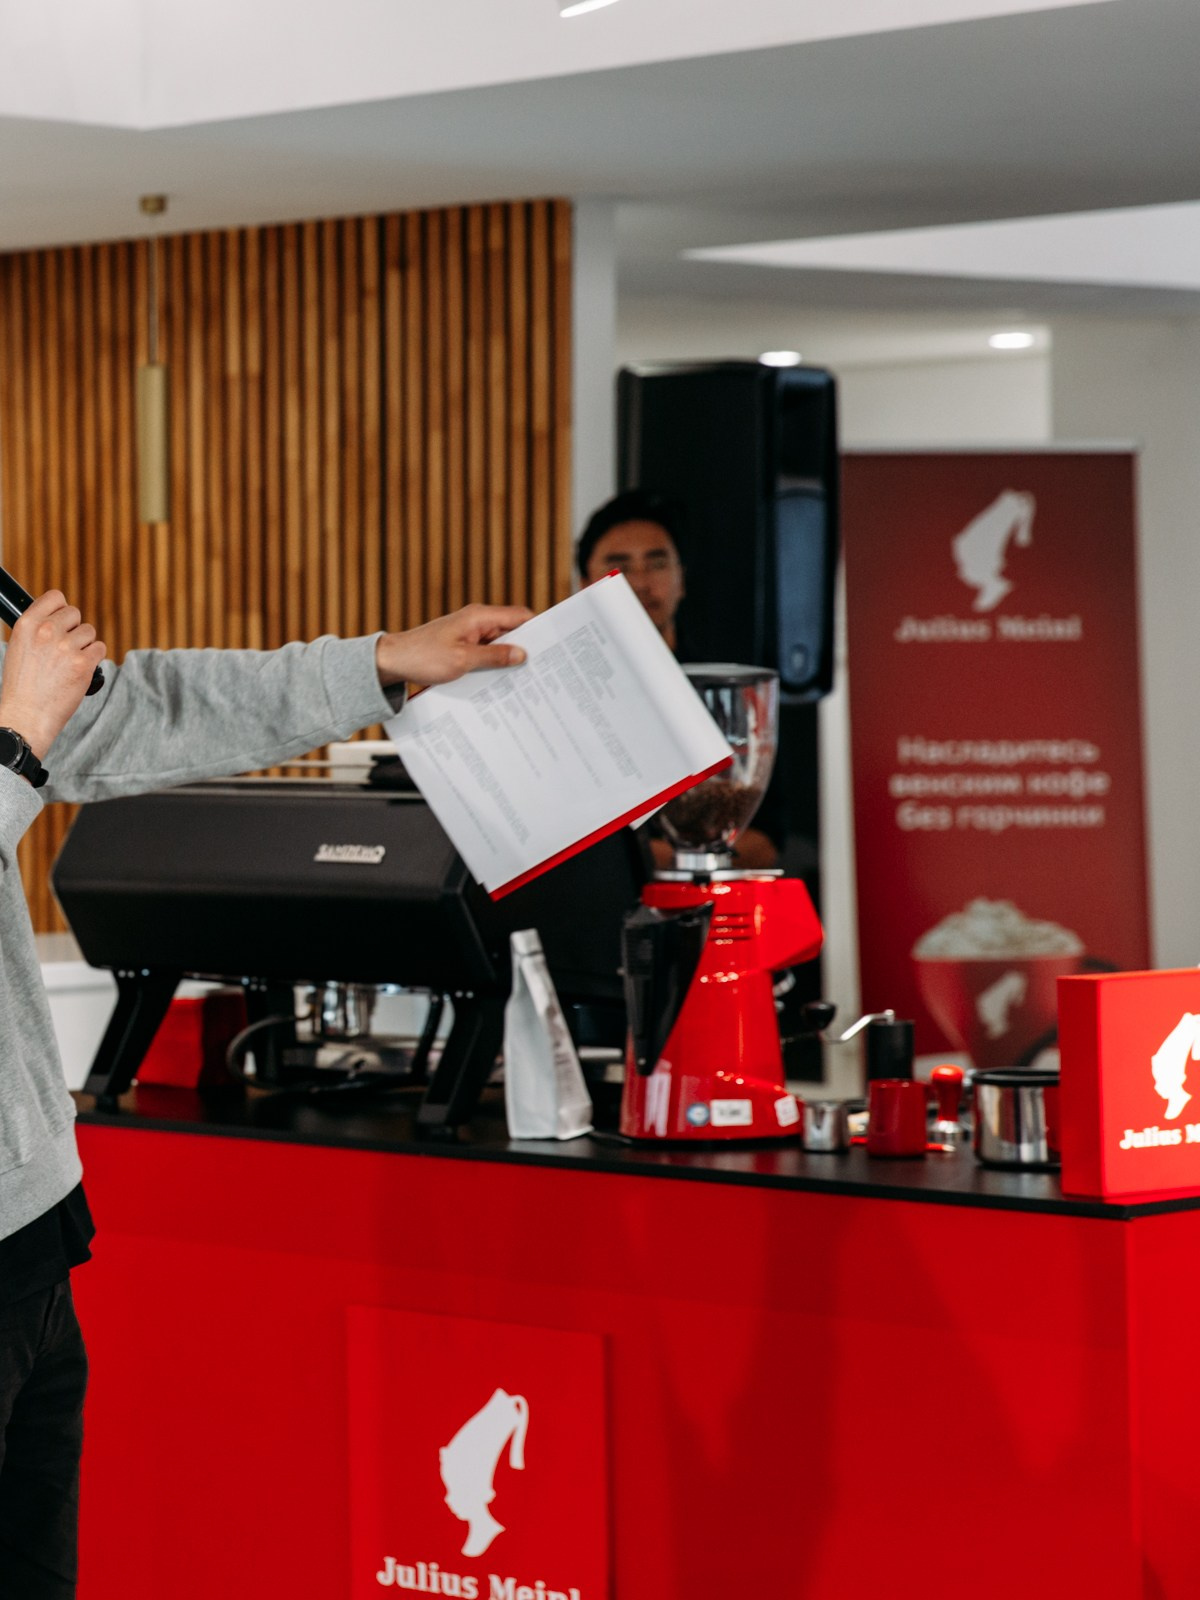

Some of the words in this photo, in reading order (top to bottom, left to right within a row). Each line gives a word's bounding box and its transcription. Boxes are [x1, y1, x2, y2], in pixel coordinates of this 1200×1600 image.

[895, 616, 991, 641] Julius
[997, 615, 1082, 640] Meinl
[1119, 1126, 1182, 1149] Julius
[376, 1556, 478, 1600] Julius
